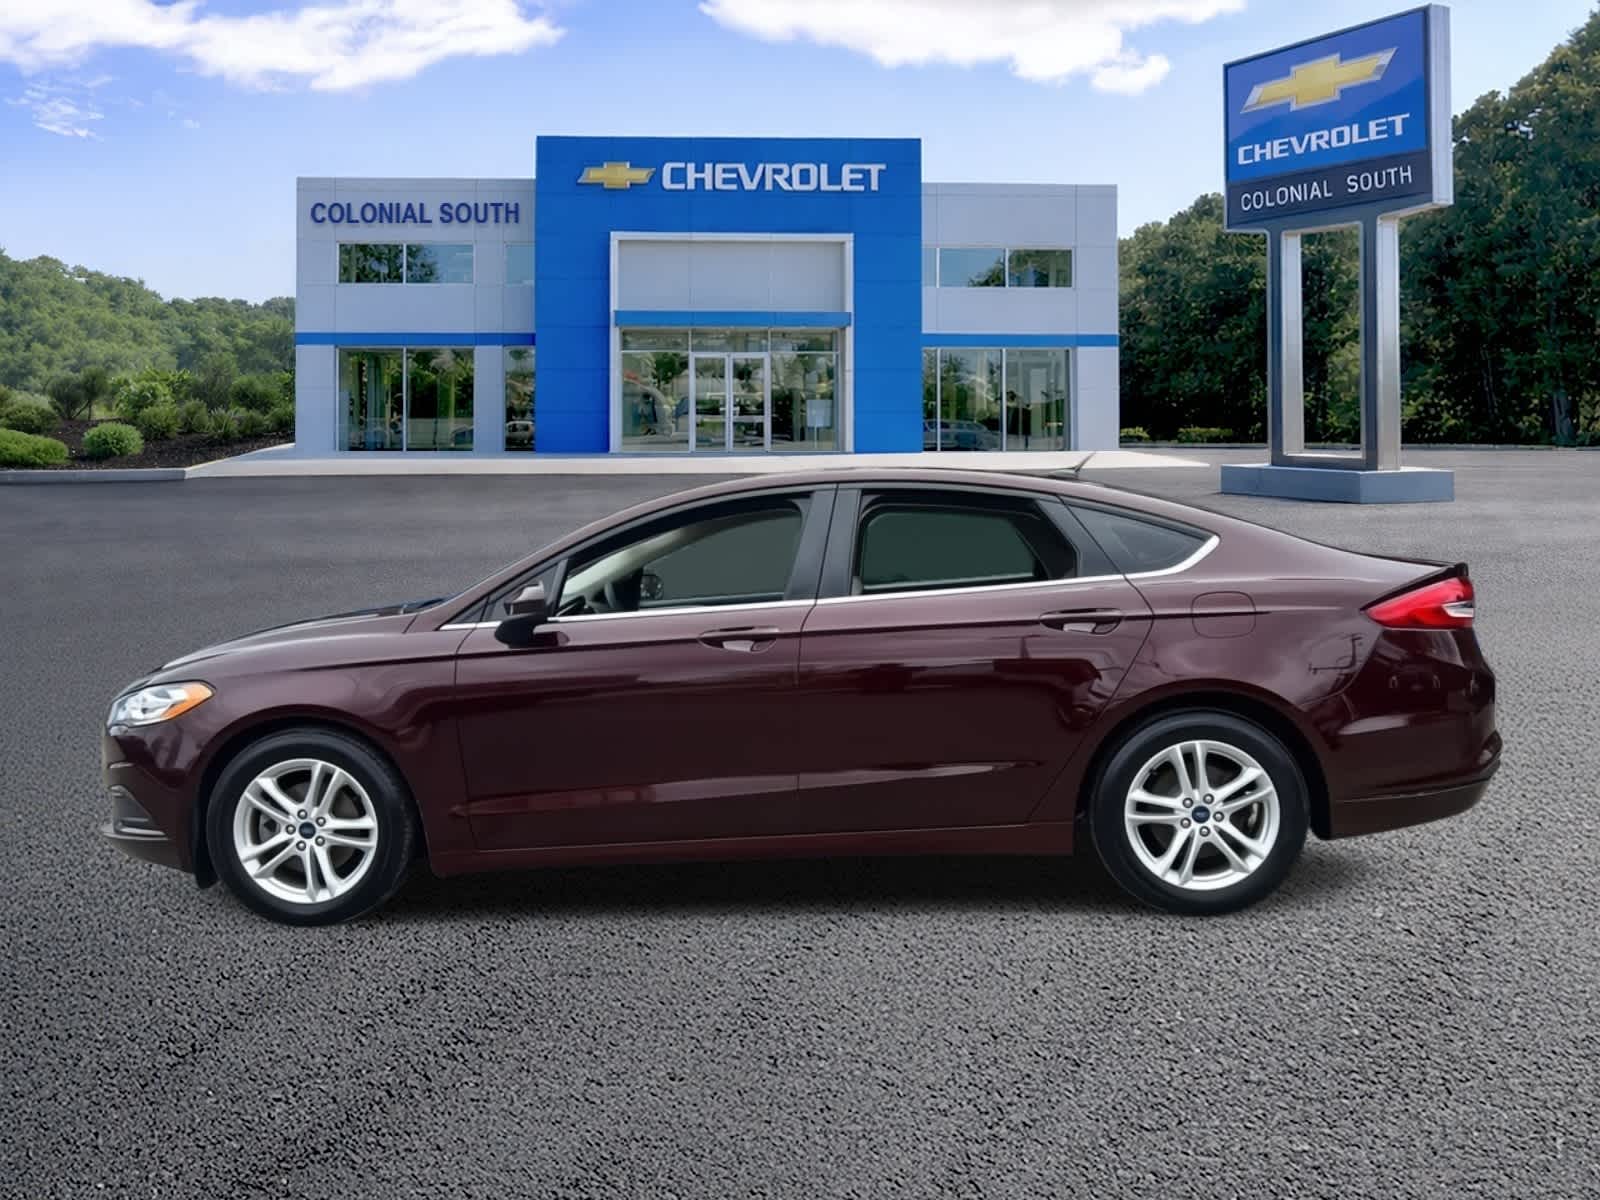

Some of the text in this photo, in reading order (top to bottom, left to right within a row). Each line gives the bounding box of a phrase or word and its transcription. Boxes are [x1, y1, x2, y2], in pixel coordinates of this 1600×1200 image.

[1237, 113, 1410, 165] CHEVROLET
[662, 162, 887, 191] CHEVROLET
[1240, 165, 1412, 211] COLONIAL SOUTH
[310, 202, 520, 224] COLONIAL SOUTH
